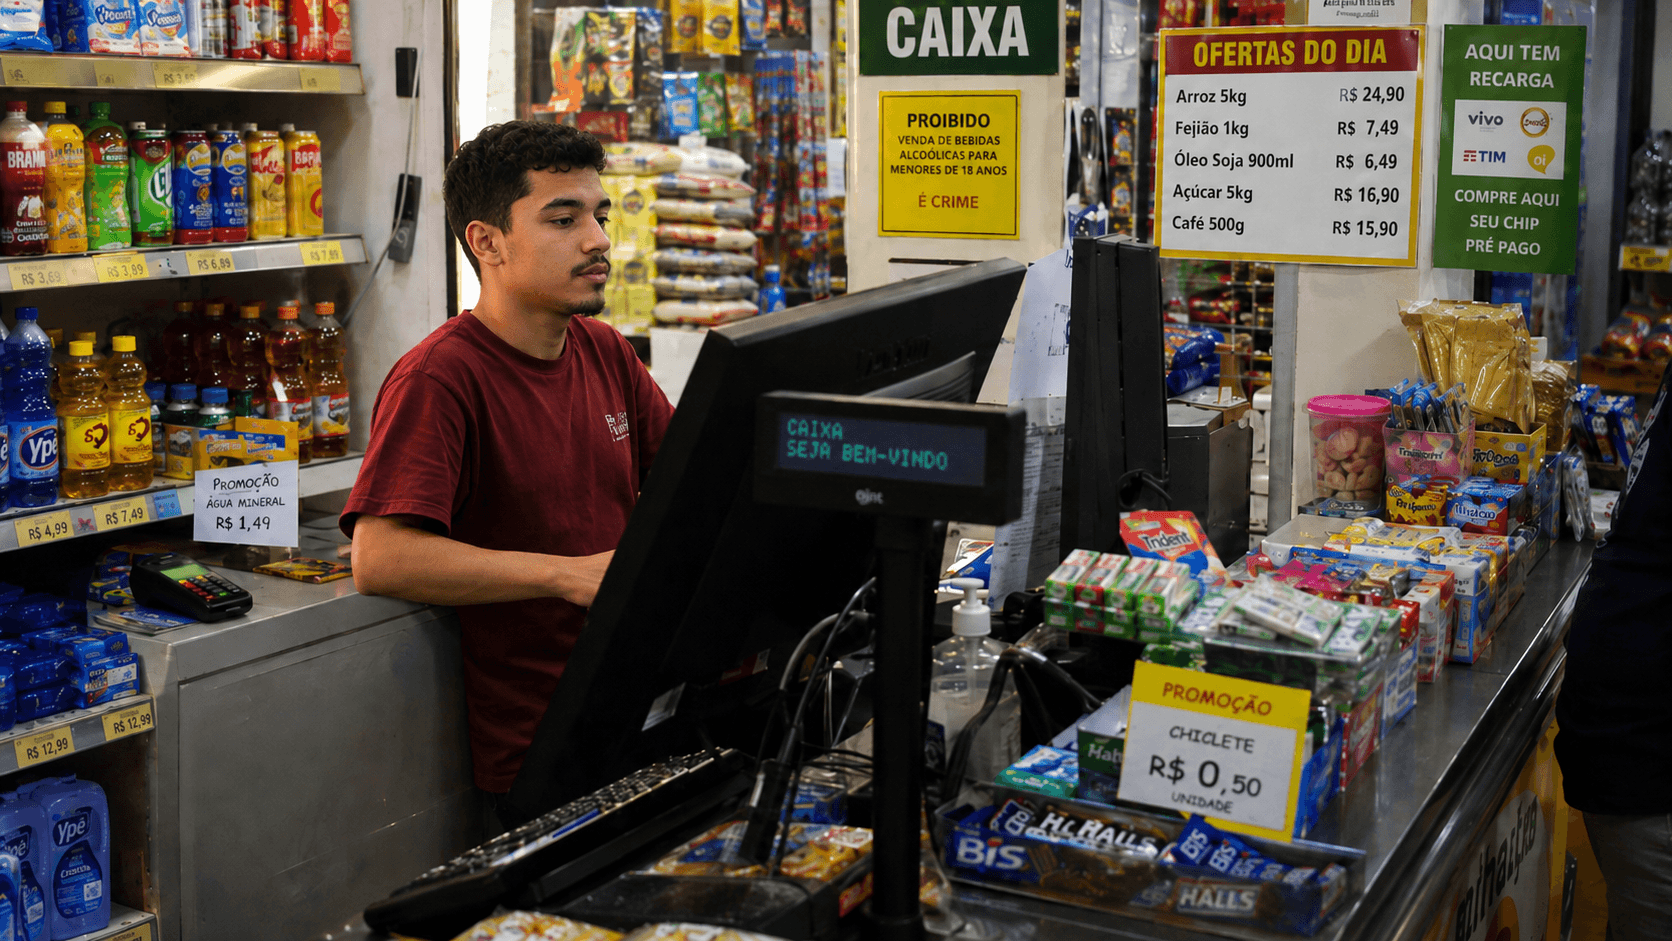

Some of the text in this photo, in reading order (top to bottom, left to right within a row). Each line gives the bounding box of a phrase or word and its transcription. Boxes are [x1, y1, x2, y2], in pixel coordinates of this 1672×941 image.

[887, 6, 1029, 58] CAIXA
[1194, 39, 1386, 67] OFERTAS DO DIA
[1465, 44, 1559, 61] AQUI TEM
[1470, 72, 1554, 88] RECARGA
[1176, 87, 1404, 106] Arroz 5kg R$ 24,90
[908, 113, 990, 128] PROIBIDO
[1468, 111, 1503, 125] vivo
[1176, 120, 1398, 138] Fejião 1kg R$ 7,49
[898, 136, 1000, 145] VENDA DE BEBIDAS
[900, 147, 997, 160] ALCOÓLICAS PARA
[1175, 149, 1397, 171] Óleo Soja 900ml R$ 6,49
[1478, 151, 1506, 163] TIM
[1534, 153, 1546, 167] oi
[891, 165, 1007, 175] MENORES DE 18 ANOS
[919, 192, 978, 208] É CRIME
[1173, 184, 1399, 204] Açúcar 5kg R$ 16,90
[1455, 190, 1559, 207] COMPRE AQUI
[1173, 216, 1397, 238] Café 500g R$ 15,90
[1470, 215, 1539, 230] SEU CHIP
[1466, 237, 1540, 255] PRÉ PAGO
[787, 418, 843, 440] CAIXA
[28, 434, 58, 465] Ypé
[787, 440, 949, 471] SEJA BEM-VINDO
[206, 495, 285, 509] ÁGUA MINERAL
[106, 508, 142, 525] R$ 7,49
[216, 516, 270, 531] R$ 1,49
[29, 522, 67, 540] R$ 4,99
[1162, 682, 1272, 716] PROMOÇÃO
[114, 713, 150, 733] R$ 12,99
[27, 738, 68, 759] R$ 12,99
[1169, 726, 1254, 753] CHICLETE
[1149, 755, 1261, 797] R$ 0,50
[1171, 791, 1233, 813] UNIDADE
[58, 817, 86, 845] Ypé
[1179, 888, 1255, 910] HALLS
